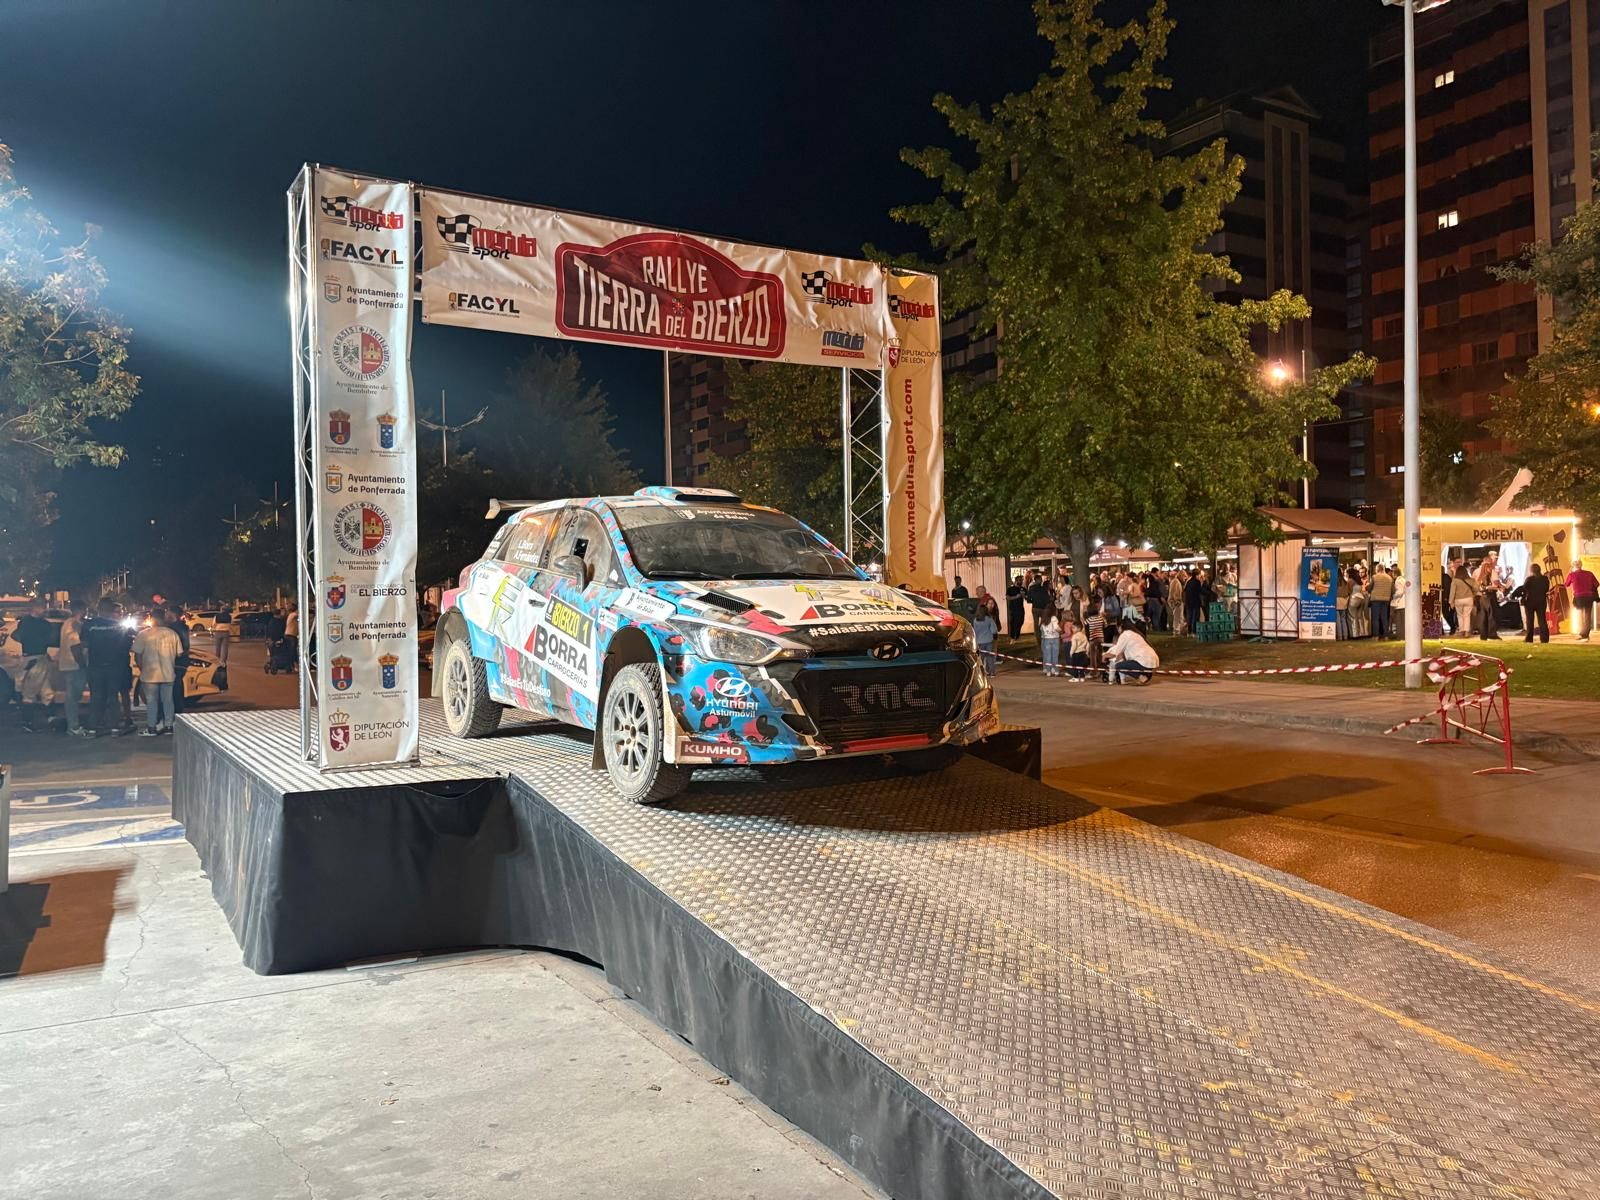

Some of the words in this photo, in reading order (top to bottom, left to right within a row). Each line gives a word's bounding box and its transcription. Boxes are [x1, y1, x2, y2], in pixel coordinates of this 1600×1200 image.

[349, 220, 381, 232] sport
[330, 240, 404, 265] FACYL
[471, 246, 510, 260] sport
[642, 256, 708, 294] RALLYE
[346, 285, 403, 299] Ayuntamiento
[346, 296, 358, 304] de
[359, 297, 403, 309] Ponferrada
[457, 293, 520, 314] FACYL
[573, 255, 661, 335] TIERRA
[665, 314, 687, 338] DEL
[690, 285, 771, 347] BIERZO
[826, 297, 853, 309] sport
[348, 473, 406, 485] Ayuntamiento
[904, 379, 917, 573] www.medulasport.com
[348, 485, 359, 493] de
[360, 485, 406, 496] Ponferrada
[359, 588, 371, 597] EL
[372, 588, 408, 597] BIERZO
[814, 604, 914, 618] BORRA
[349, 621, 407, 631] Ayuntamiento
[808, 624, 936, 638] #SalasEsTuDestino
[349, 632, 360, 641] de
[361, 631, 407, 643] Ponferrada
[534, 623, 588, 676] BORRA
[706, 699, 759, 710] HYUNDAI
[709, 708, 756, 718] Asturmóvil
[354, 720, 410, 732] DIPUTACIÓN
[354, 733, 367, 741] DE
[368, 730, 393, 740] LEÓN
[684, 744, 742, 756] KUMHO
